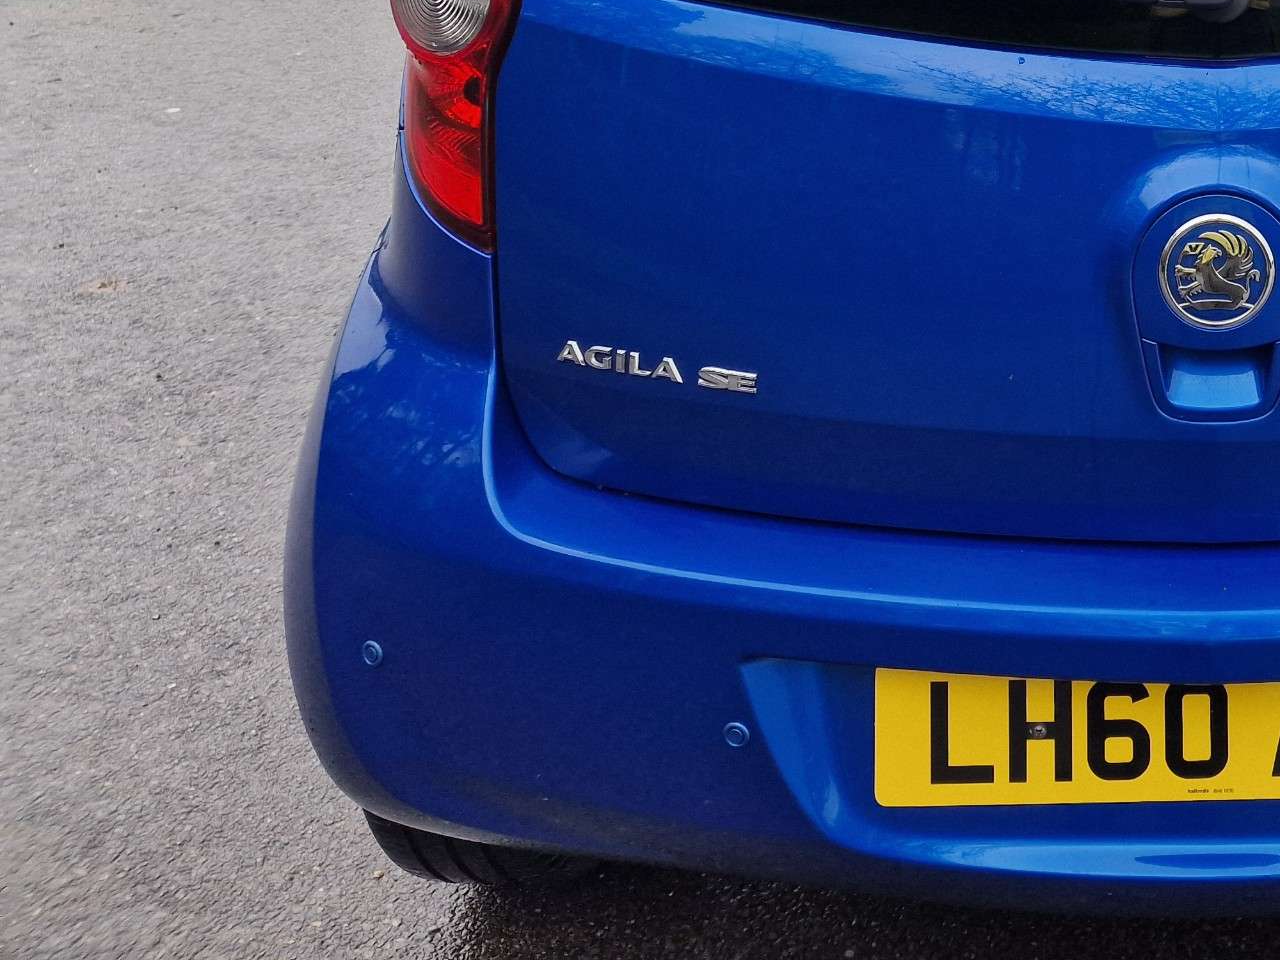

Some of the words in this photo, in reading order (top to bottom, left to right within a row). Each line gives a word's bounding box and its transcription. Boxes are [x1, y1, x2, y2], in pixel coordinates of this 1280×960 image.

[557, 340, 684, 384] AGILA
[698, 366, 758, 394] SE
[930, 677, 1229, 784] LH60
